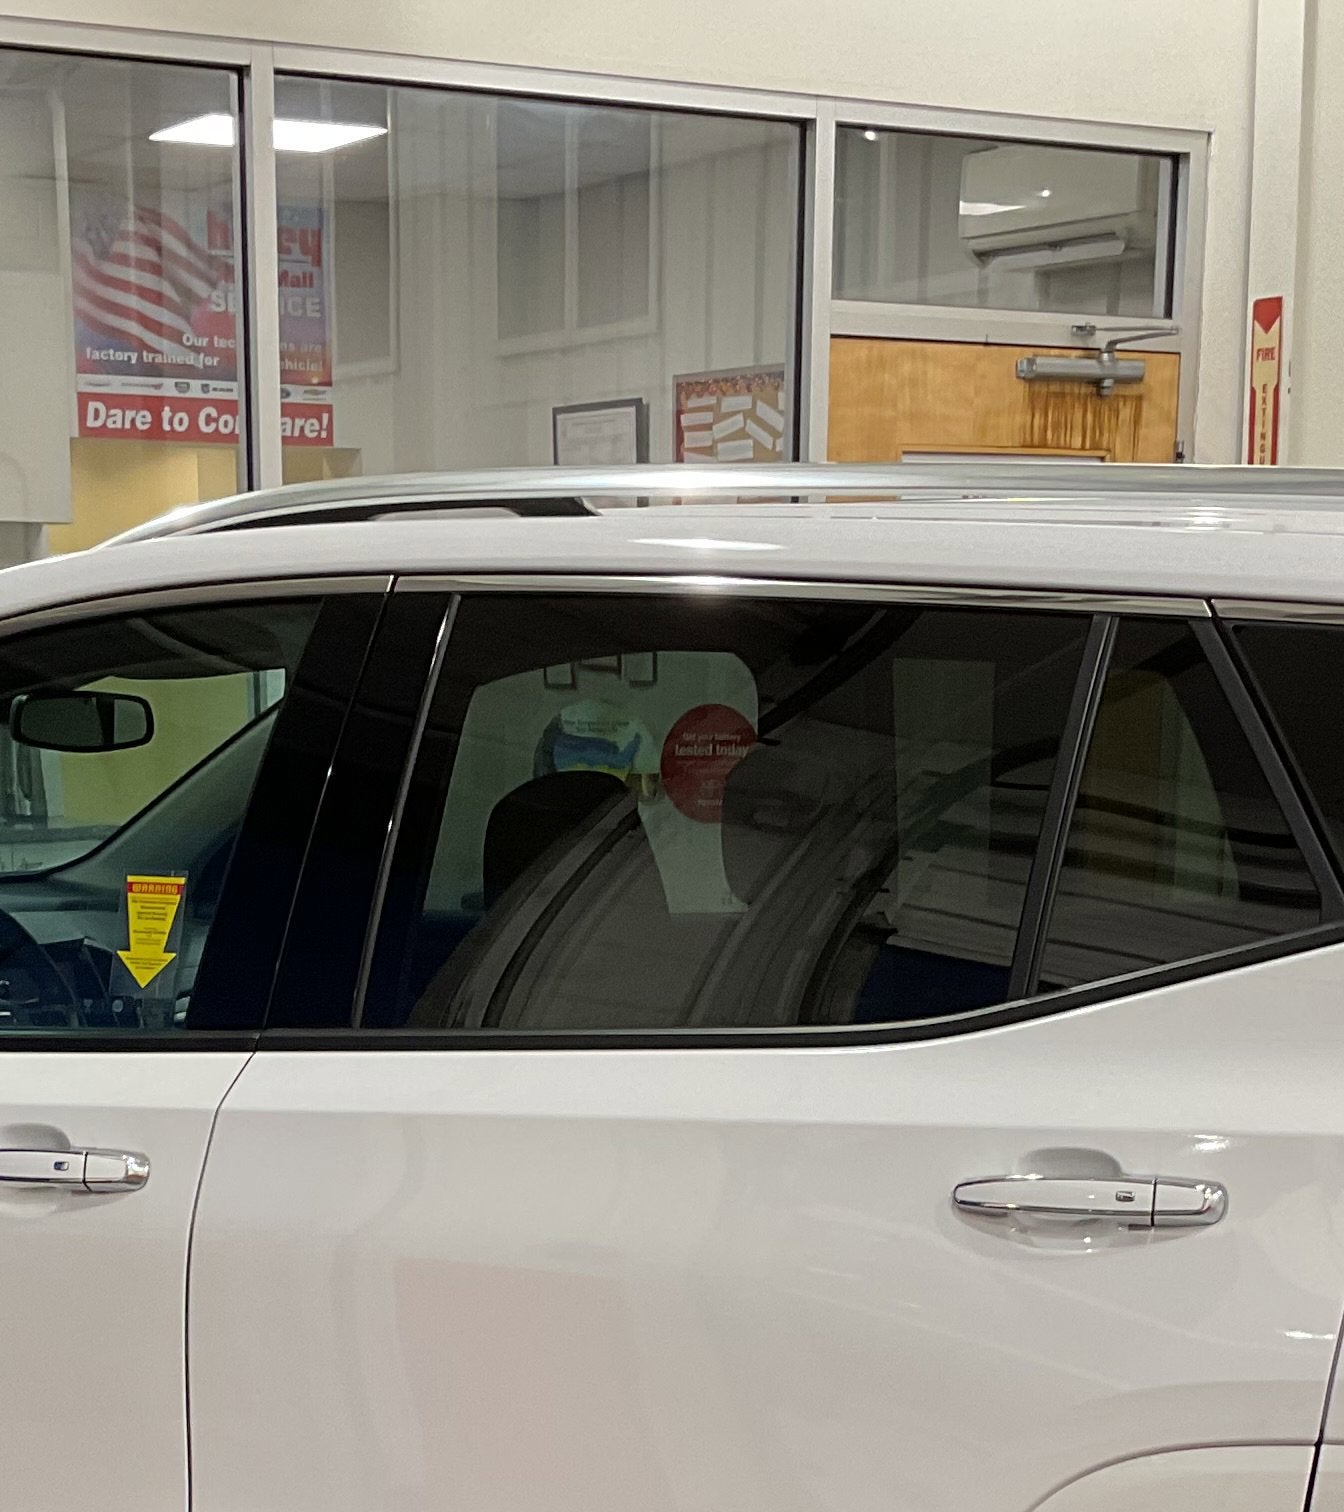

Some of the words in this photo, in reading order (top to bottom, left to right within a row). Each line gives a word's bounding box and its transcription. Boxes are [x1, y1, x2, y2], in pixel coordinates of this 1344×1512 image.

[182, 334, 208, 348] Our
[86, 347, 138, 364] factory
[142, 350, 194, 365] trained
[195, 354, 220, 369] for
[1256, 347, 1276, 361] FIRE
[86, 401, 152, 430] Dare
[161, 406, 189, 432] to
[198, 407, 329, 439] Coare!
[675, 743, 713, 757] tested
[131, 883, 178, 895] WARNING
